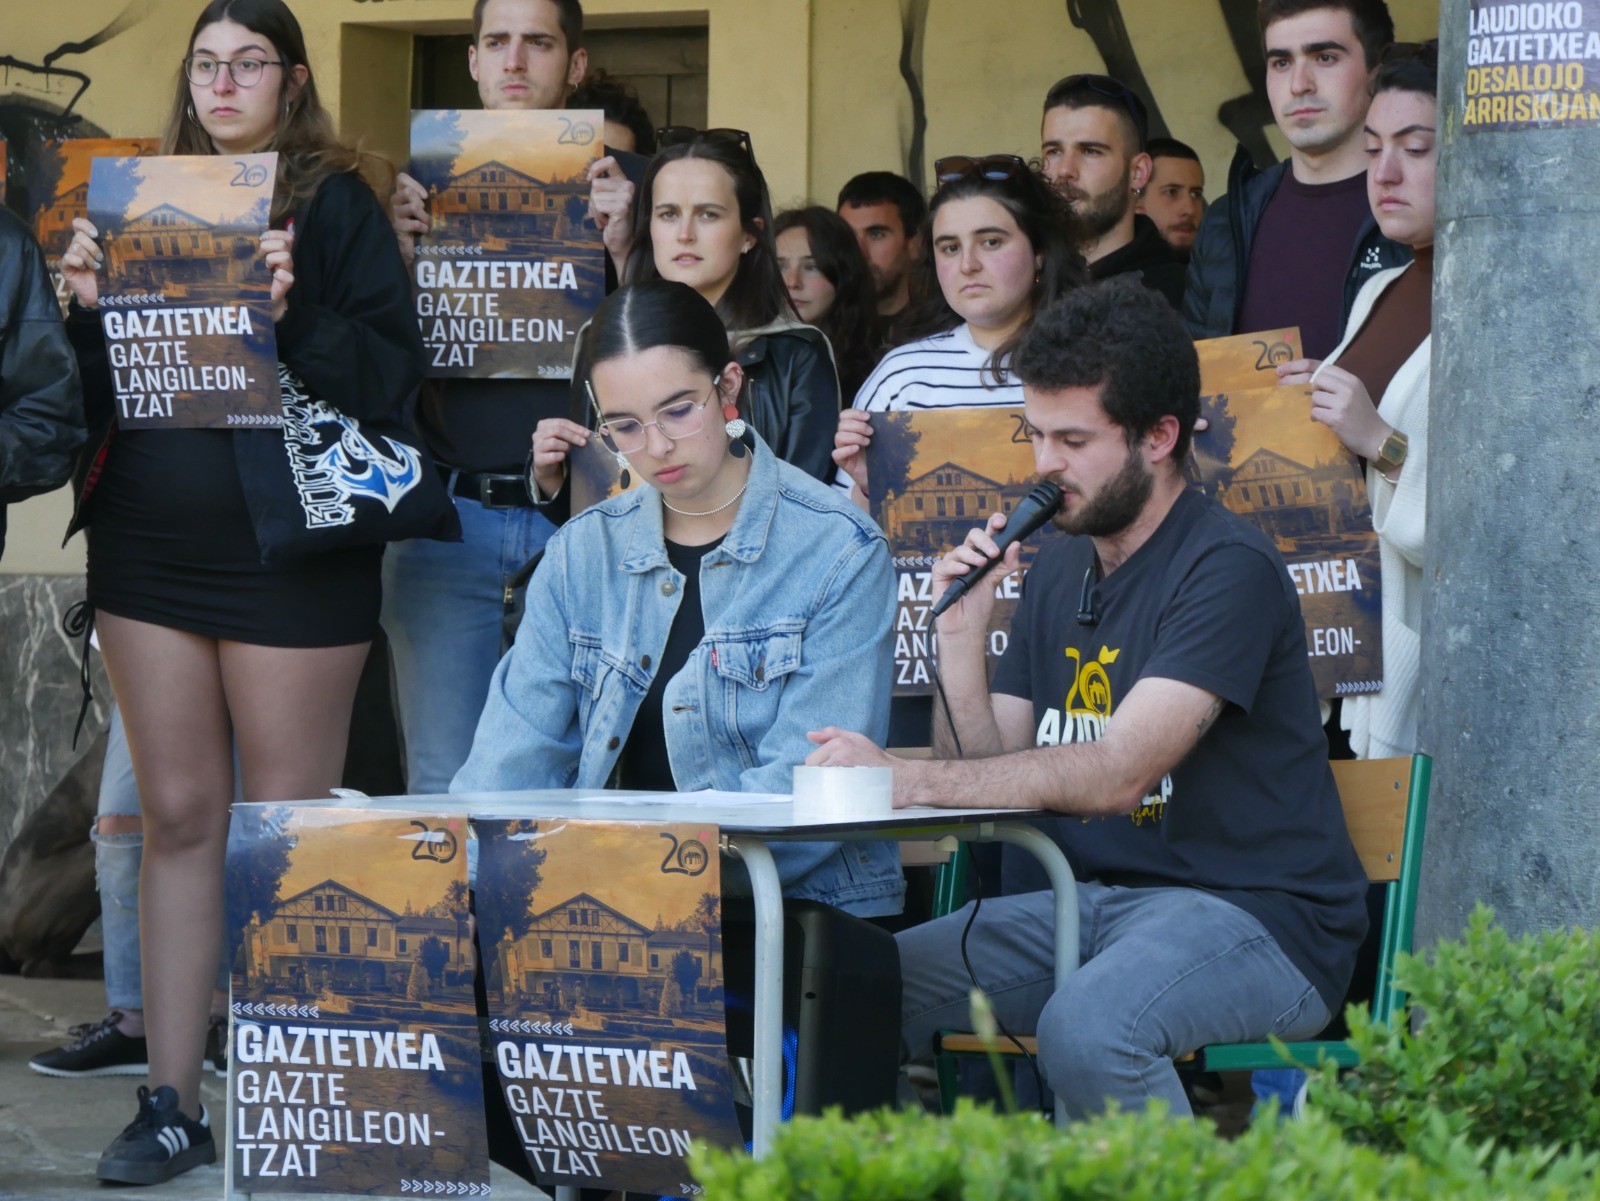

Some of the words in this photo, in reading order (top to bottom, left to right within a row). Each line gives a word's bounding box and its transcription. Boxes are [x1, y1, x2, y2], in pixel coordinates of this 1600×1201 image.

[1469, 1, 1583, 36] LAUDIOKO
[1467, 31, 1600, 66] GAZTETXEA
[1466, 62, 1584, 96] DESALOJO
[416, 260, 578, 290] GAZTETXEA
[416, 292, 499, 317] GAZTE
[104, 306, 253, 340] GAZTETXEA
[109, 340, 189, 368] GAZTE
[114, 365, 255, 393] LANGILEON-
[116, 392, 175, 418] TZAT
[1287, 559, 1362, 595] ETXEA
[237, 1024, 446, 1071] GAZTETXEA
[496, 1040, 697, 1091] GAZTETXEA
[237, 1070, 347, 1106] GAZTE
[506, 1084, 609, 1121] GAZTE
[238, 1107, 446, 1146] LANGILEON-
[236, 1143, 322, 1177] TZAT
[525, 1146, 602, 1177] TZAT
